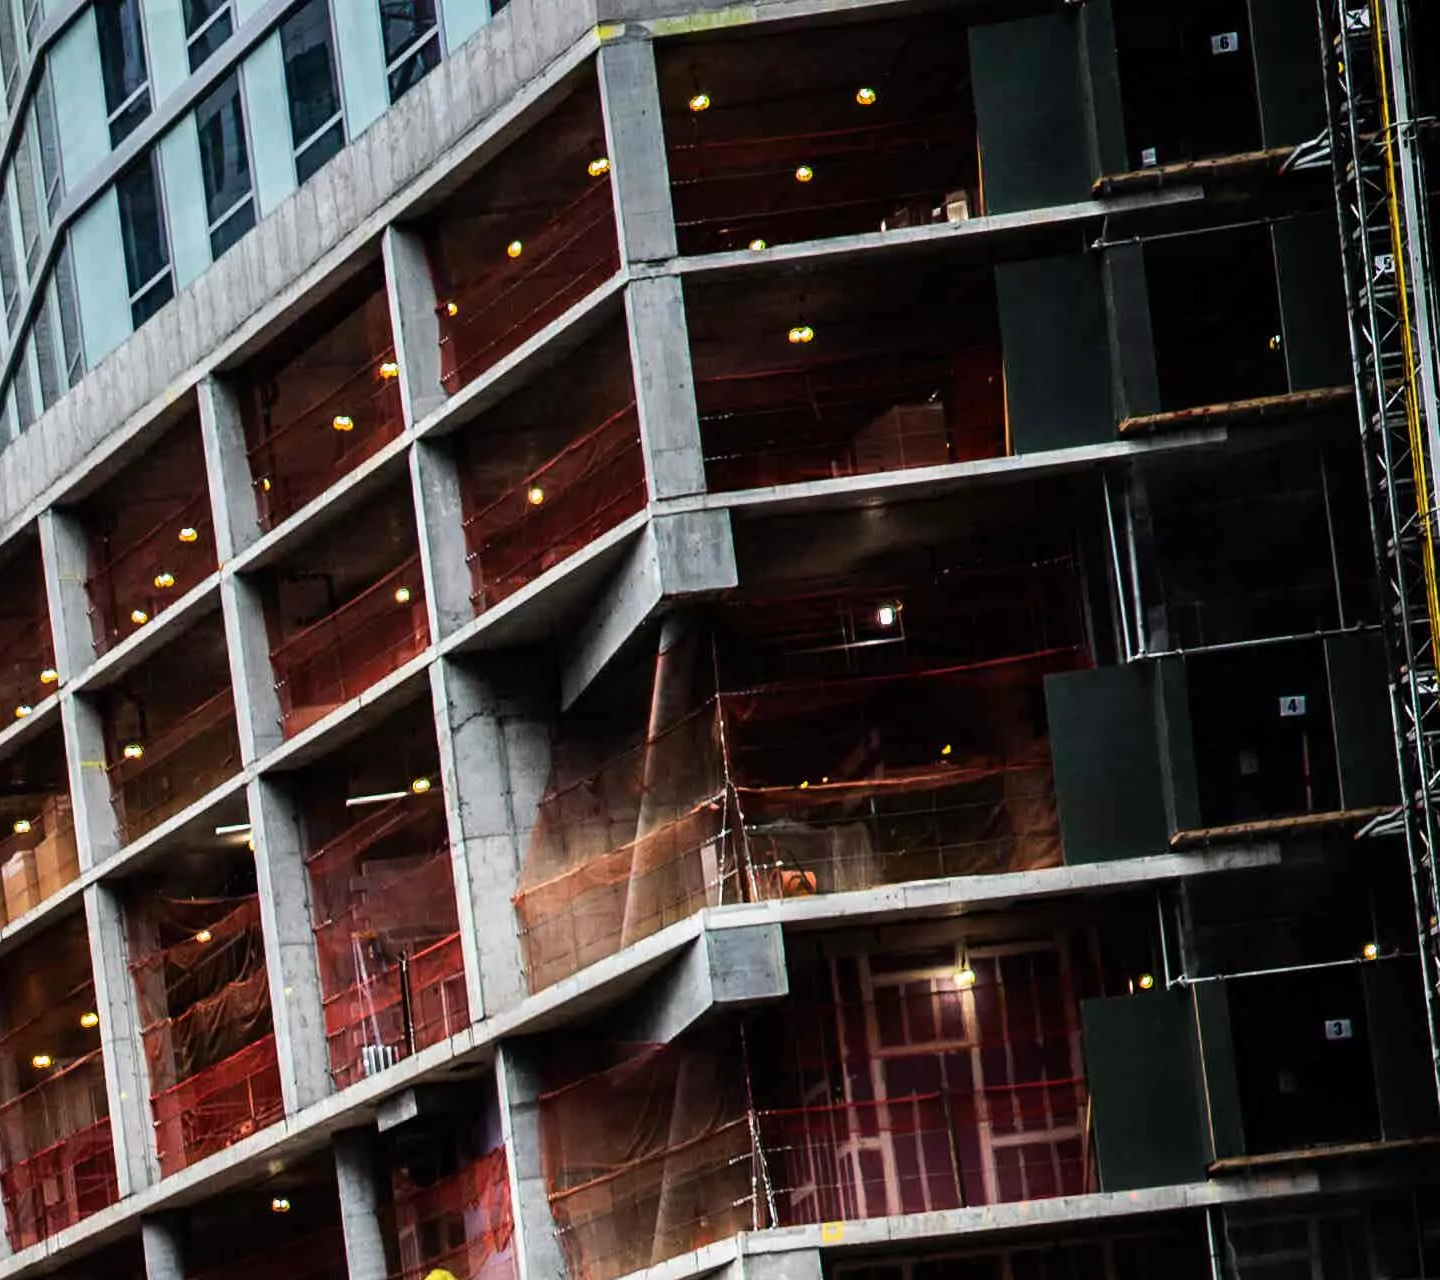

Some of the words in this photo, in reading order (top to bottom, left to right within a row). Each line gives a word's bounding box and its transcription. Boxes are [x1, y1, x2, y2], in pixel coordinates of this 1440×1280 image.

[1220, 36, 1228, 49] 6
[1288, 699, 1297, 713] 4
[1334, 1022, 1342, 1036] 3
